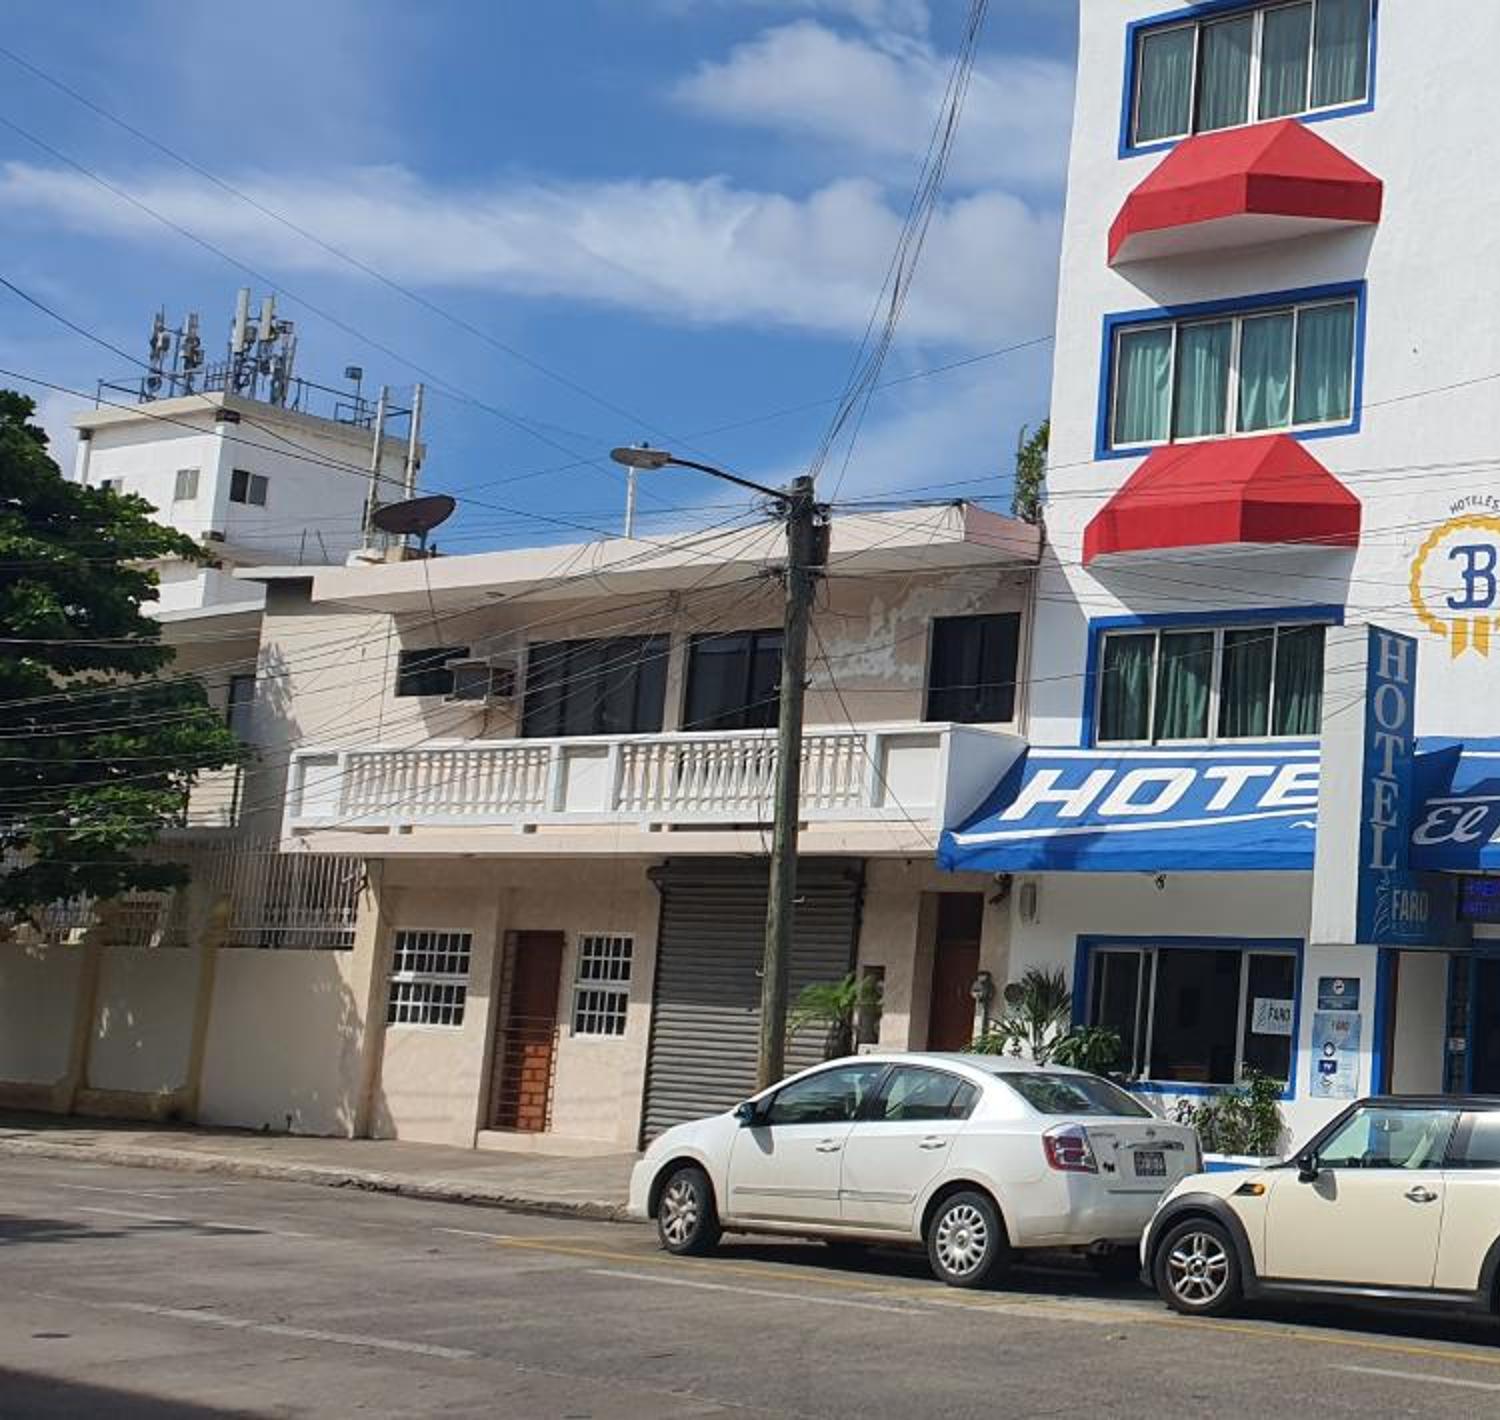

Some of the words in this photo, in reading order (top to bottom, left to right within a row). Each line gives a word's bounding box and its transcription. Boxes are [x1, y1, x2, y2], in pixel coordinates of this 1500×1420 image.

[1450, 495, 1500, 514] HOTELES
[1369, 632, 1411, 870] HOTEL
[999, 764, 1321, 821] HOTE
[1411, 804, 1490, 845] El
[1391, 889, 1429, 922] FARO
